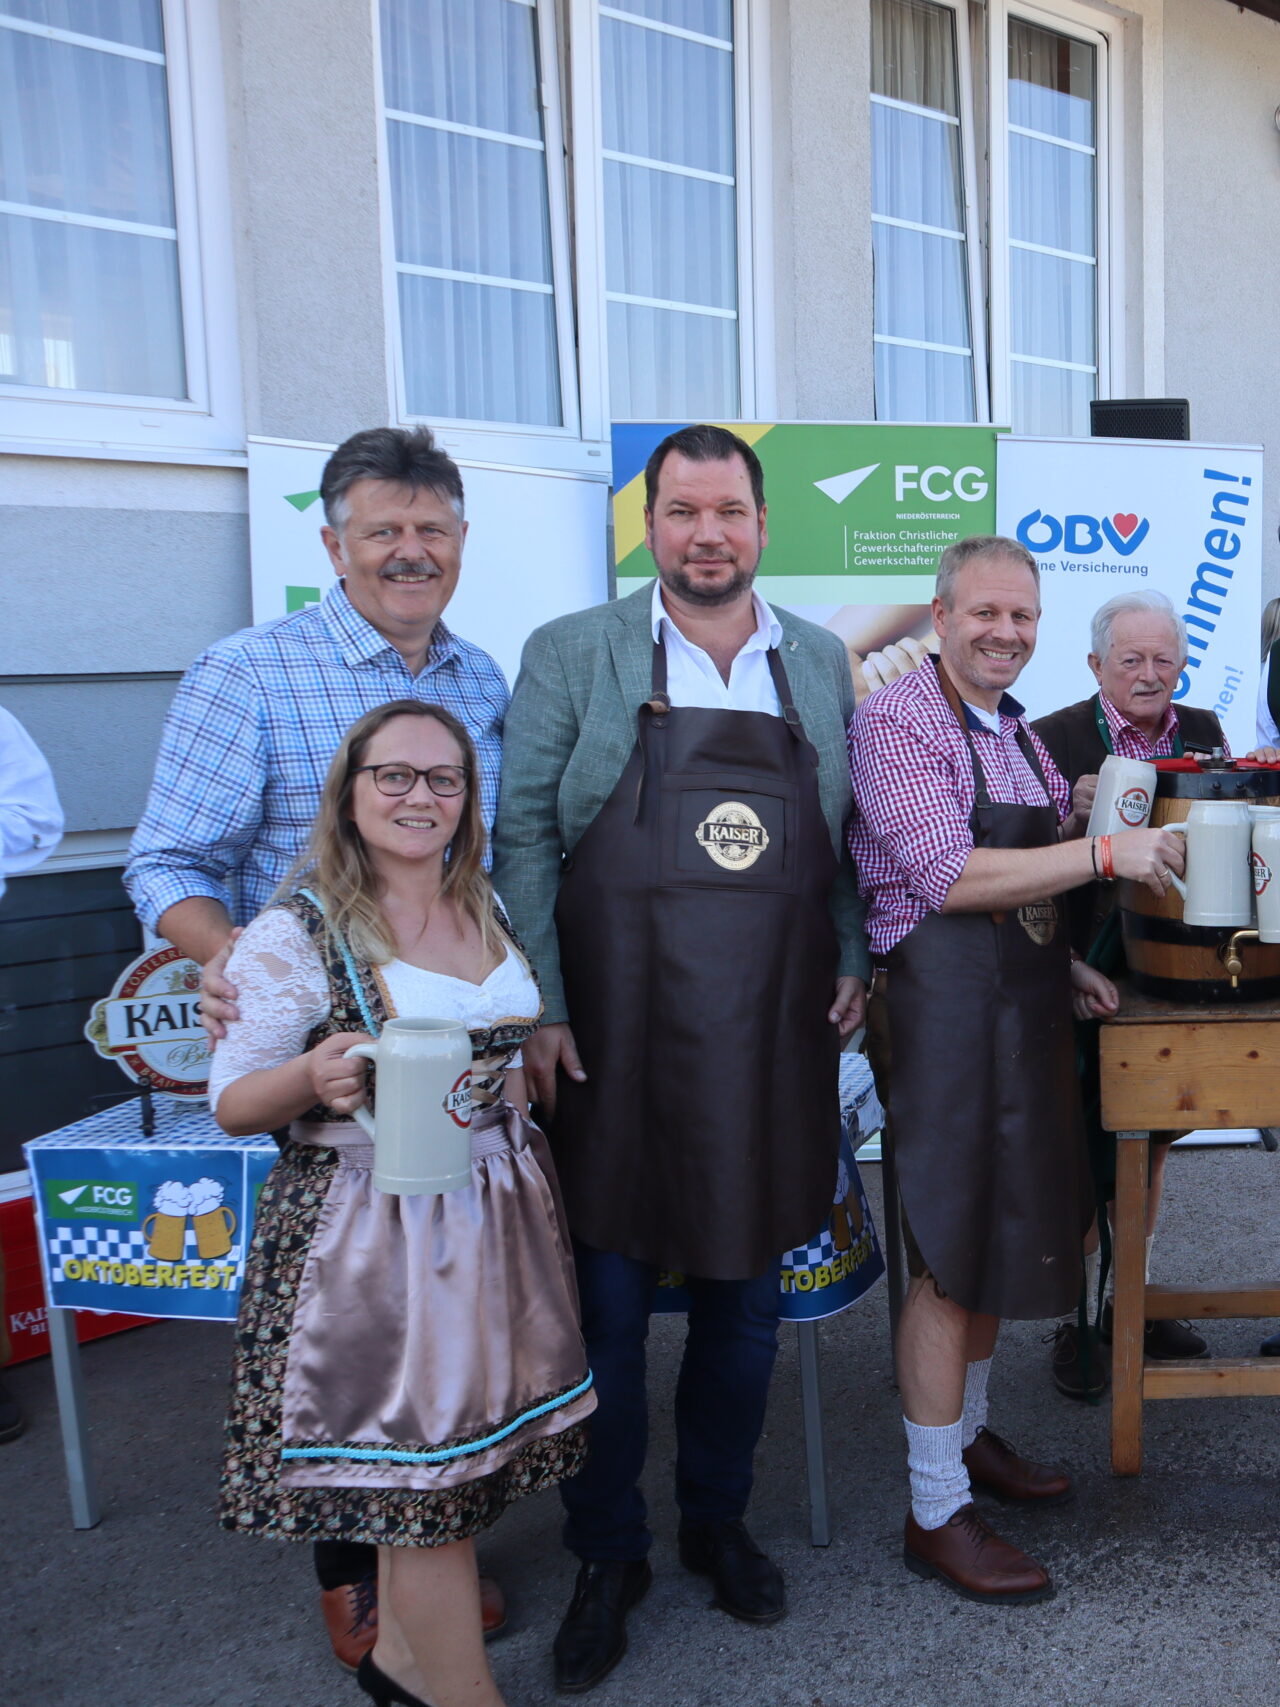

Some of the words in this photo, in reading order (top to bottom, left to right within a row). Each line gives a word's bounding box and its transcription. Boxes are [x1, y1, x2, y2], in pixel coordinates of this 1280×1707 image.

[894, 464, 989, 502] FCG
[895, 512, 961, 520] NIEDERÖSTERREICH
[853, 530, 896, 540] Fraktion
[899, 530, 959, 540] Christlicher
[853, 556, 934, 566] Gewerkschafter
[1060, 561, 1148, 577] Versicherung
[1121, 799, 1147, 813] KAISER
[708, 824, 760, 845] KAISER
[93, 1185, 133, 1206] FCG
[64, 1258, 236, 1290] OKTOBERFEST
